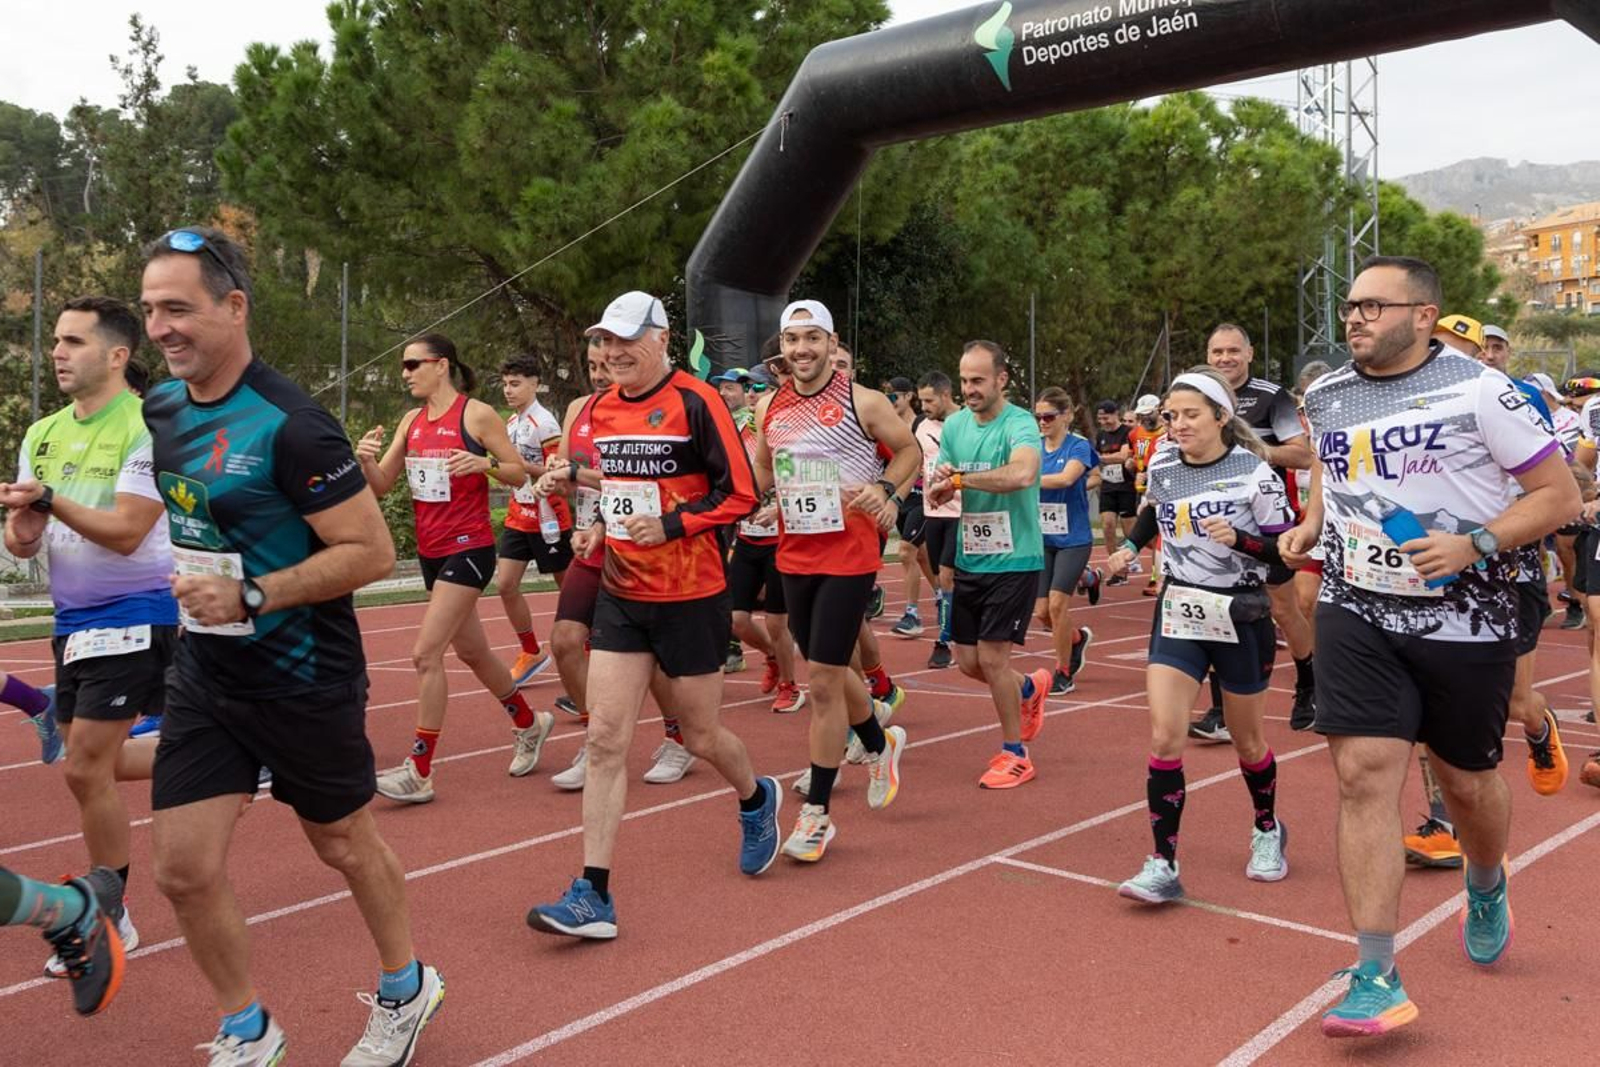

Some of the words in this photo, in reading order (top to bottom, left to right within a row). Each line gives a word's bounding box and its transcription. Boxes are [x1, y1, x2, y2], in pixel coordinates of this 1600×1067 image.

[1021, 8, 1112, 41] Patronato
[1021, 32, 1109, 66] Deportes
[1114, 23, 1141, 45] de
[1146, 10, 1198, 38] Jaén
[609, 443, 619, 455] DE
[621, 443, 673, 456] ATLETISMO
[418, 469, 426, 483] 3
[1397, 453, 1443, 487] Jaén
[612, 497, 633, 515] 28
[795, 497, 817, 513] 15
[1042, 512, 1057, 522] 14
[972, 524, 992, 538] 96
[1367, 544, 1403, 569] 26
[1180, 602, 1206, 620] 33
